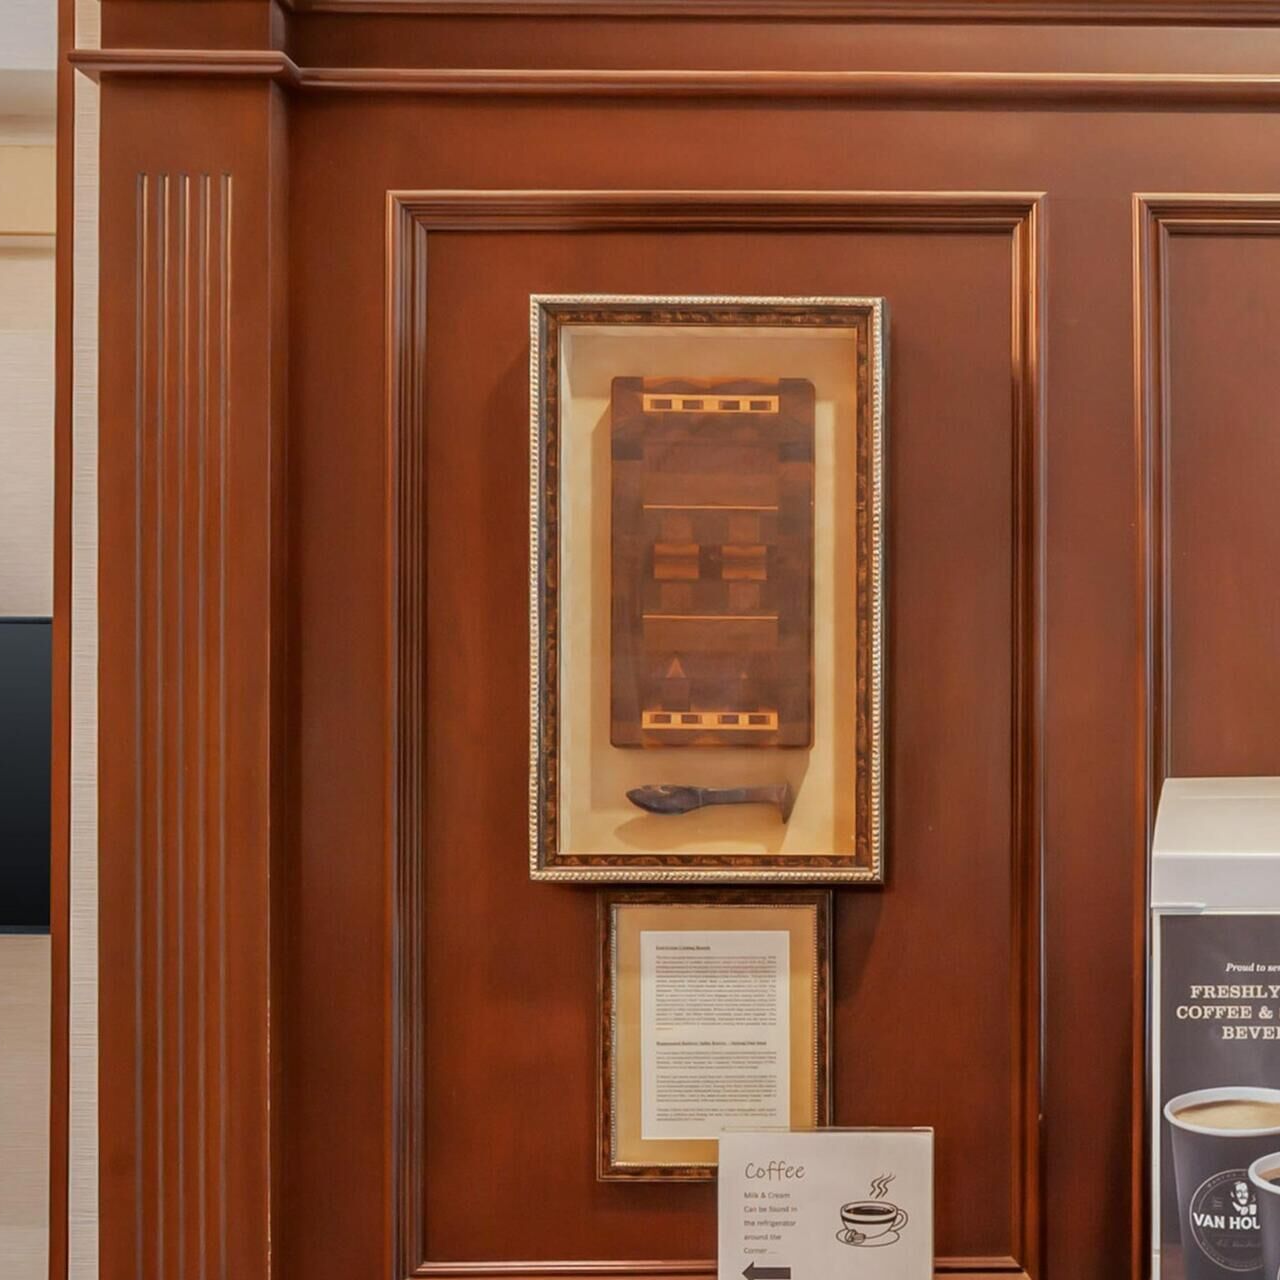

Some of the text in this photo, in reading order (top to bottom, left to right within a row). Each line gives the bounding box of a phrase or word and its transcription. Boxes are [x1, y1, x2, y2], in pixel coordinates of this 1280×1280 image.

[1225, 962, 1254, 972] Proud
[1256, 963, 1265, 972] to
[1190, 985, 1280, 999] FRESHLY
[1176, 1006, 1252, 1019] COFFEE
[1258, 1006, 1273, 1019] &
[745, 1160, 806, 1180] Coffee
[768, 1205, 789, 1213] found
[757, 1219, 796, 1228] refrigerator
[1193, 1212, 1225, 1229] VAN
